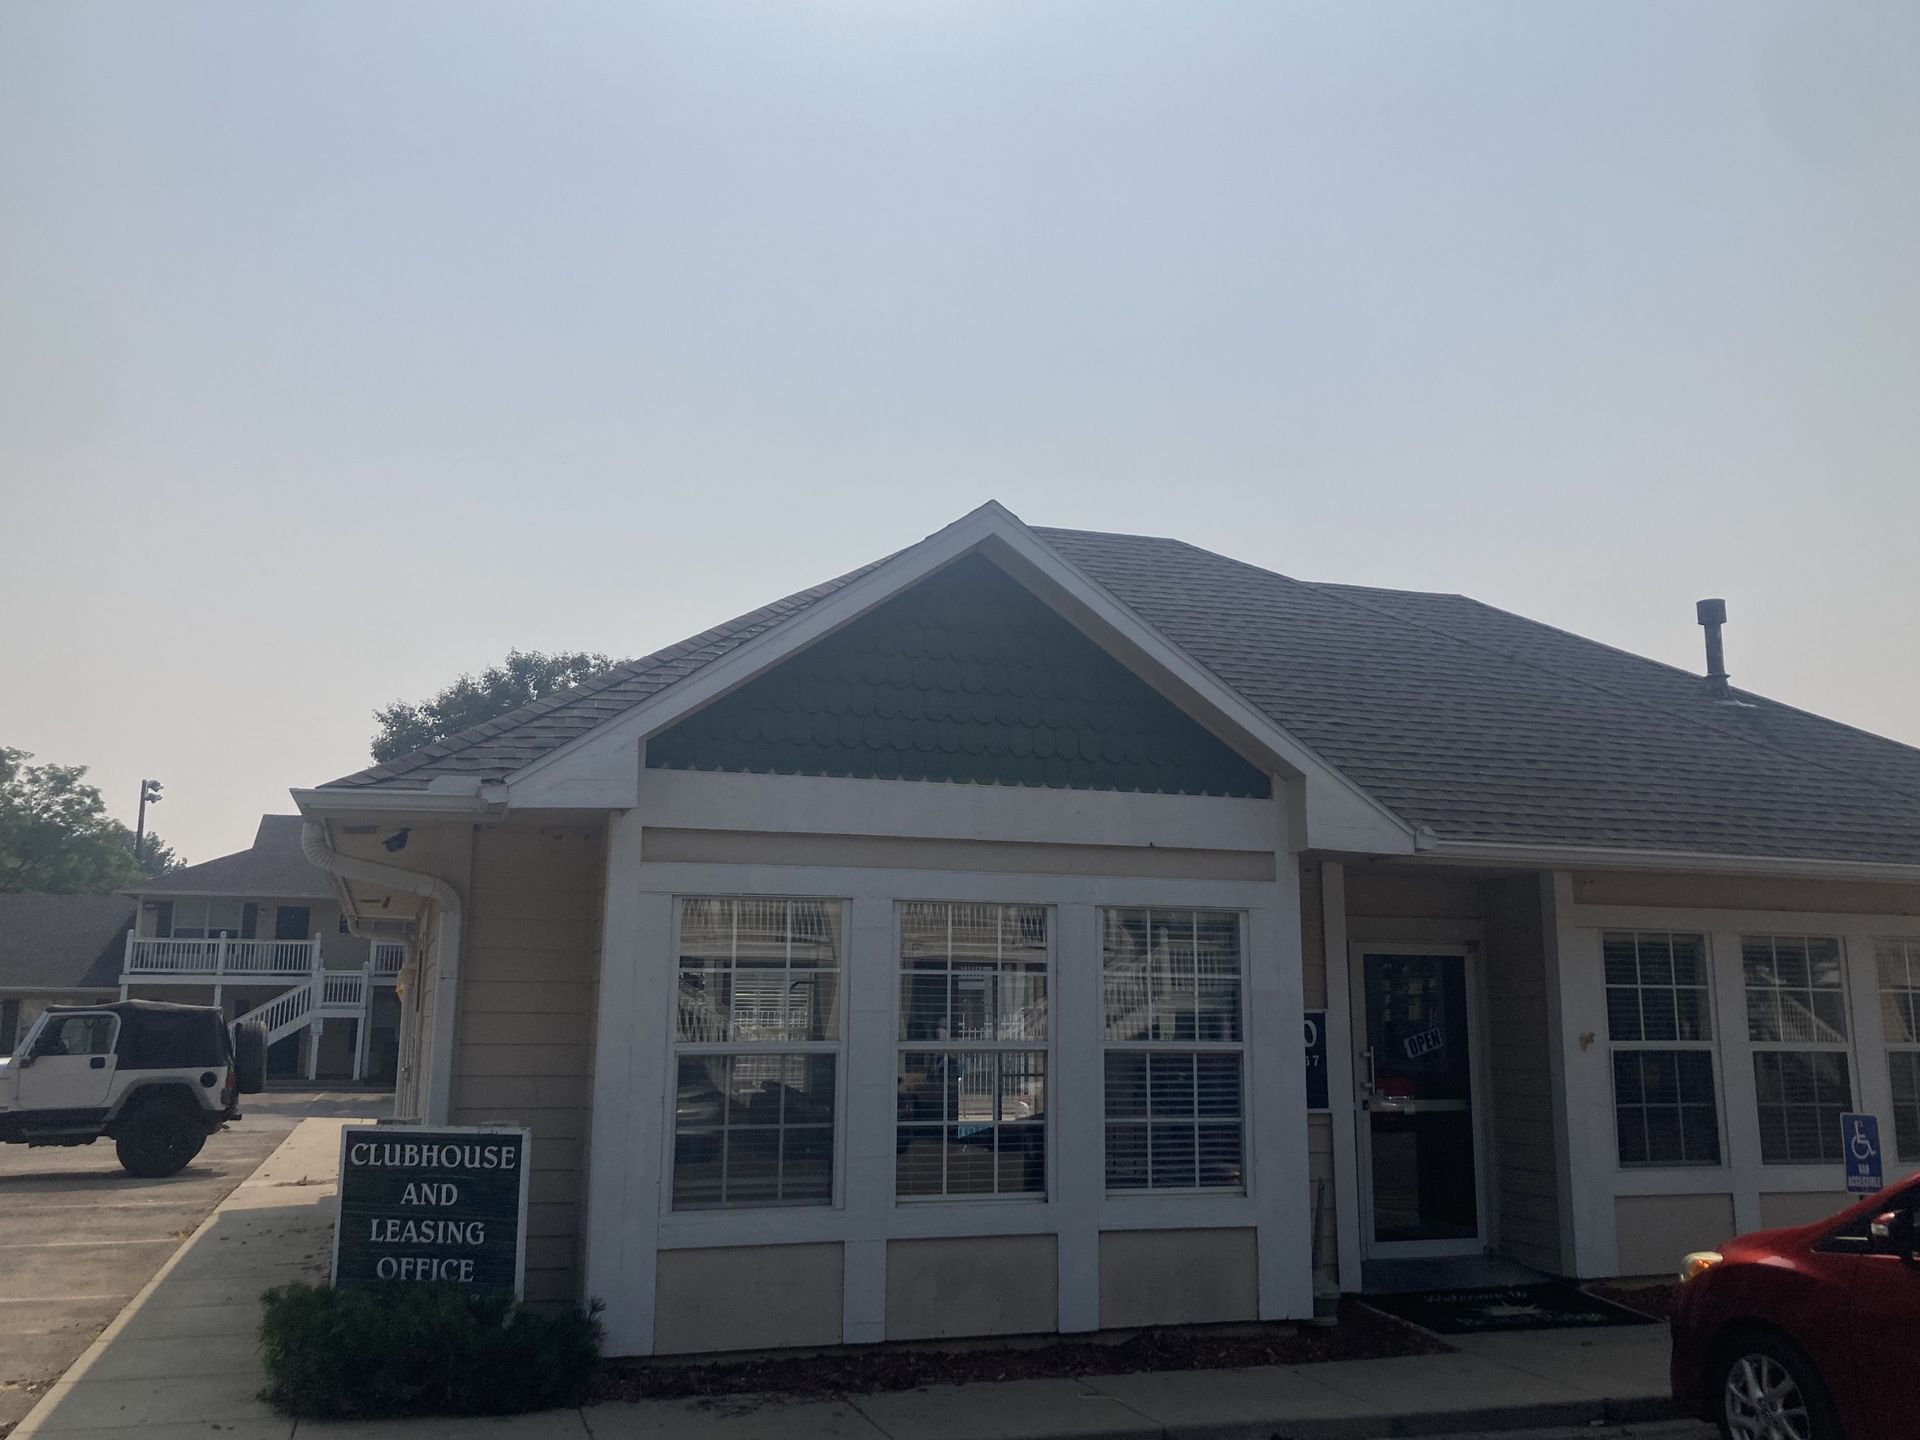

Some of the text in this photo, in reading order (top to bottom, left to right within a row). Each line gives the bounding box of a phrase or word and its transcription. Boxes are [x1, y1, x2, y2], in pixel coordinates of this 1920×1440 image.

[1407, 1028, 1442, 1056] OPEN
[350, 1142, 516, 1169] CLUBHOUSE
[400, 1182, 458, 1206] AND
[369, 1218, 485, 1245] LEASING
[376, 1256, 475, 1282] OFFICE
